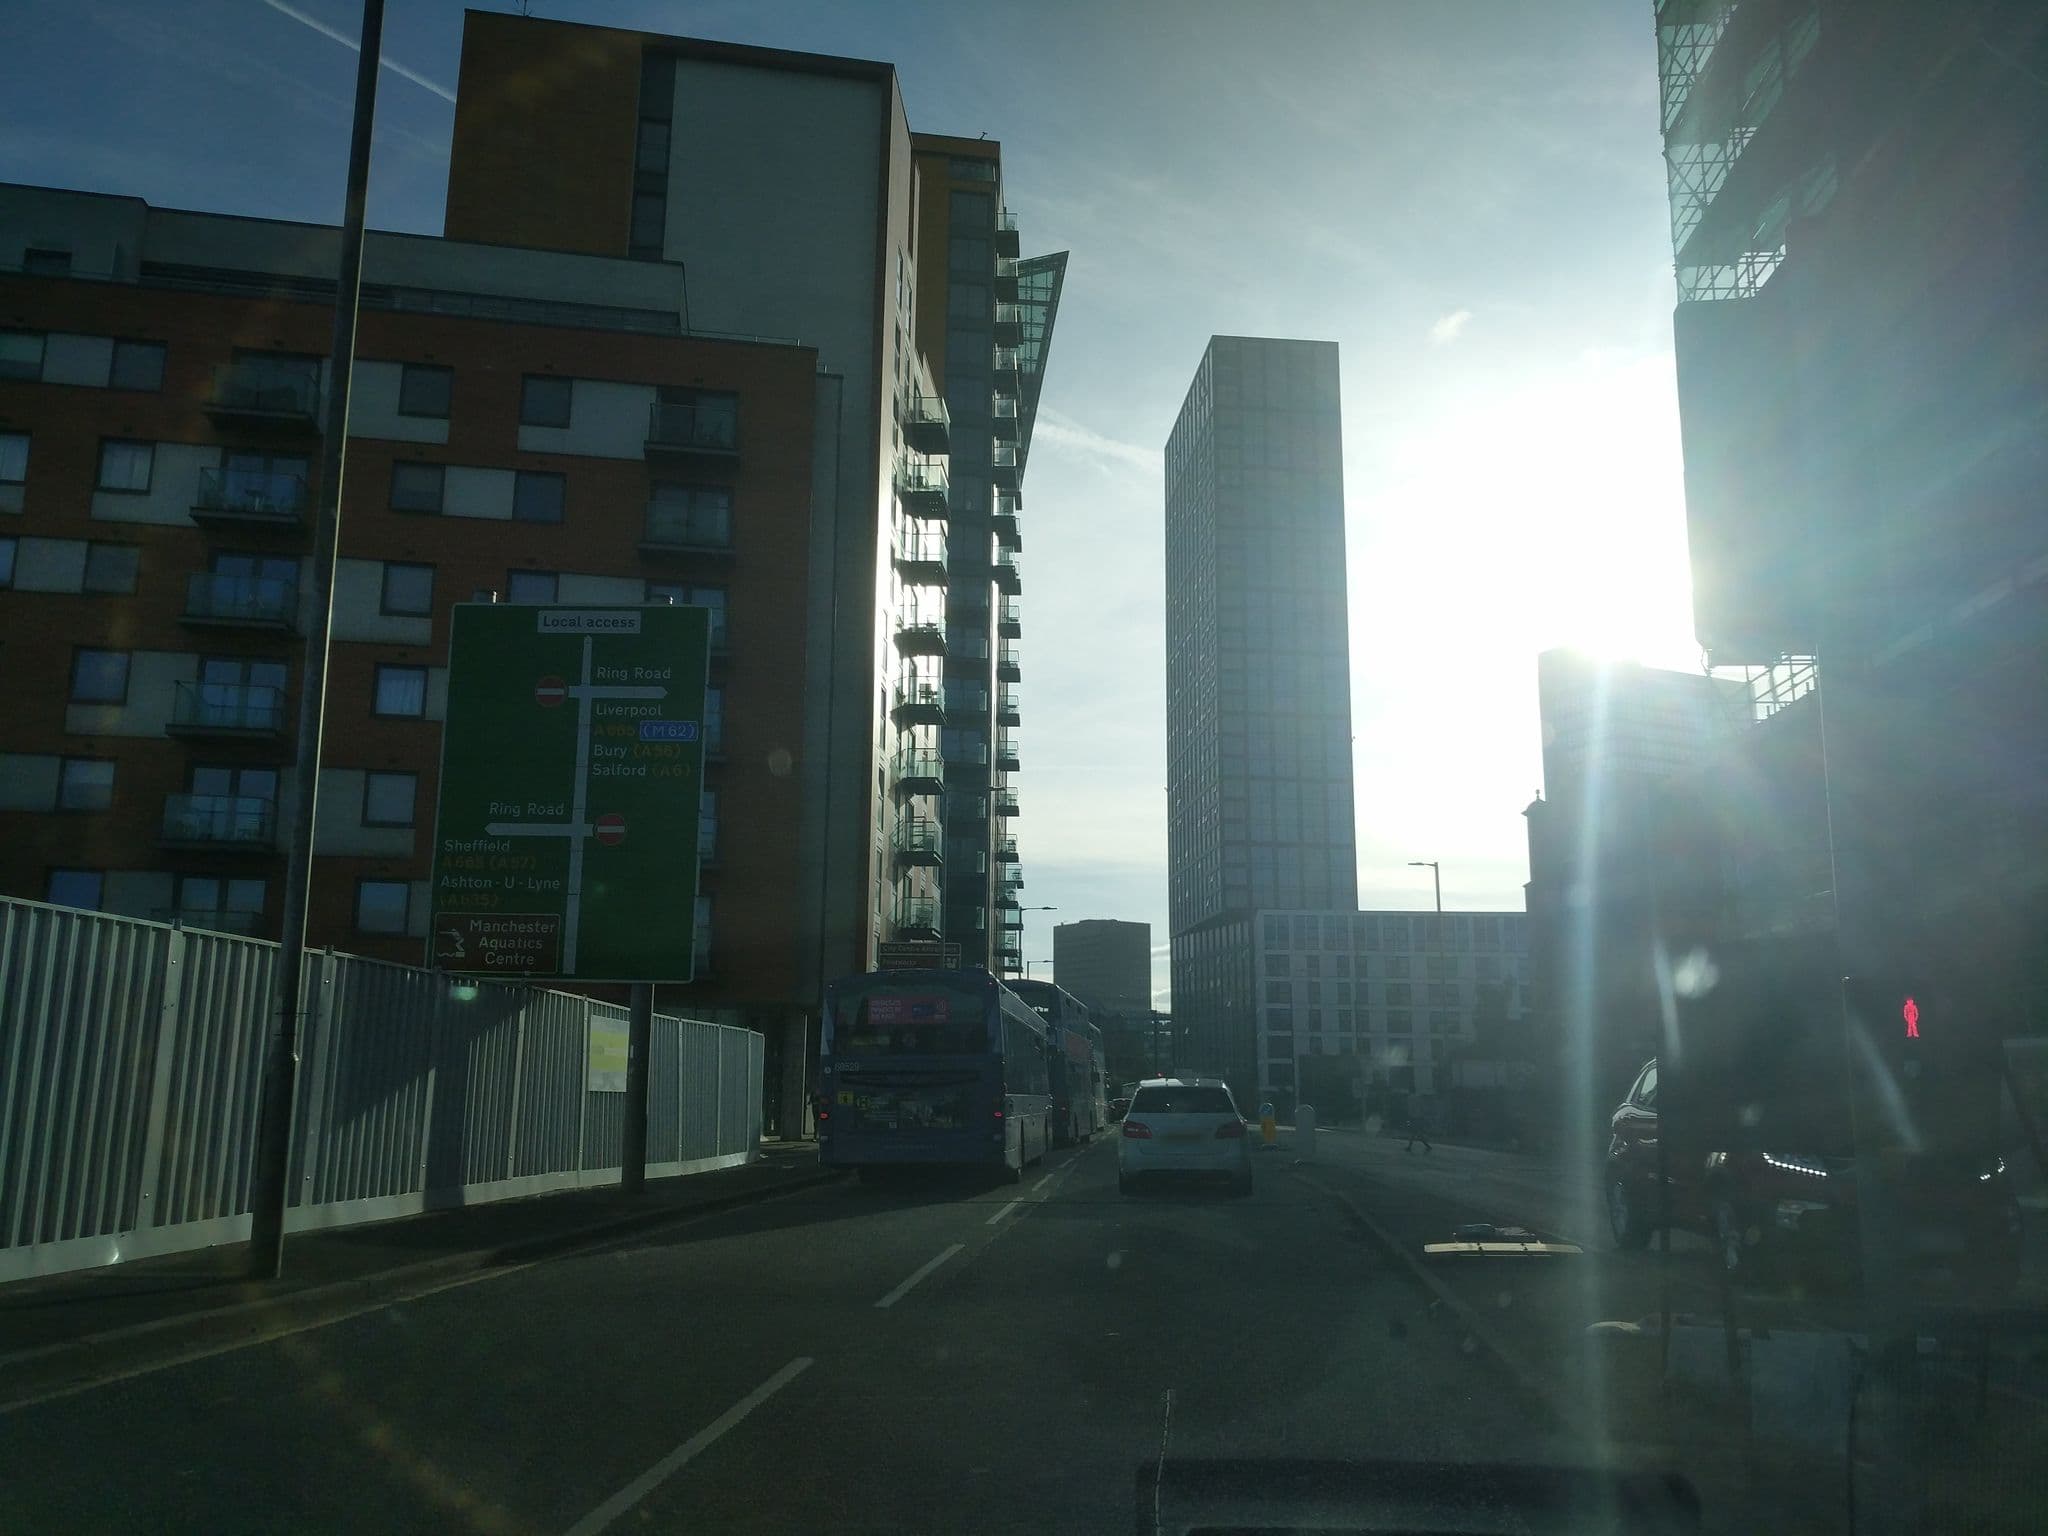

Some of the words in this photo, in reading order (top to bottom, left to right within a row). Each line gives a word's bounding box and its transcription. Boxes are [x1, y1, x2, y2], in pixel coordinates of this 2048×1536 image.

[543, 615, 581, 628] Local
[587, 617, 635, 628] access
[596, 667, 628, 682] Ring
[635, 667, 671, 680] Road
[595, 704, 663, 718] Liverpool
[593, 744, 628, 759] Bury
[592, 763, 646, 776] Salford
[488, 802, 520, 817] Ring
[527, 802, 565, 816] Road
[444, 839, 511, 852] Sheffield
[440, 875, 492, 888] Ashton
[528, 876, 561, 892] Lyne
[469, 920, 556, 933] Manchester
[479, 936, 543, 950] Aquatics
[484, 952, 535, 966] Centre
